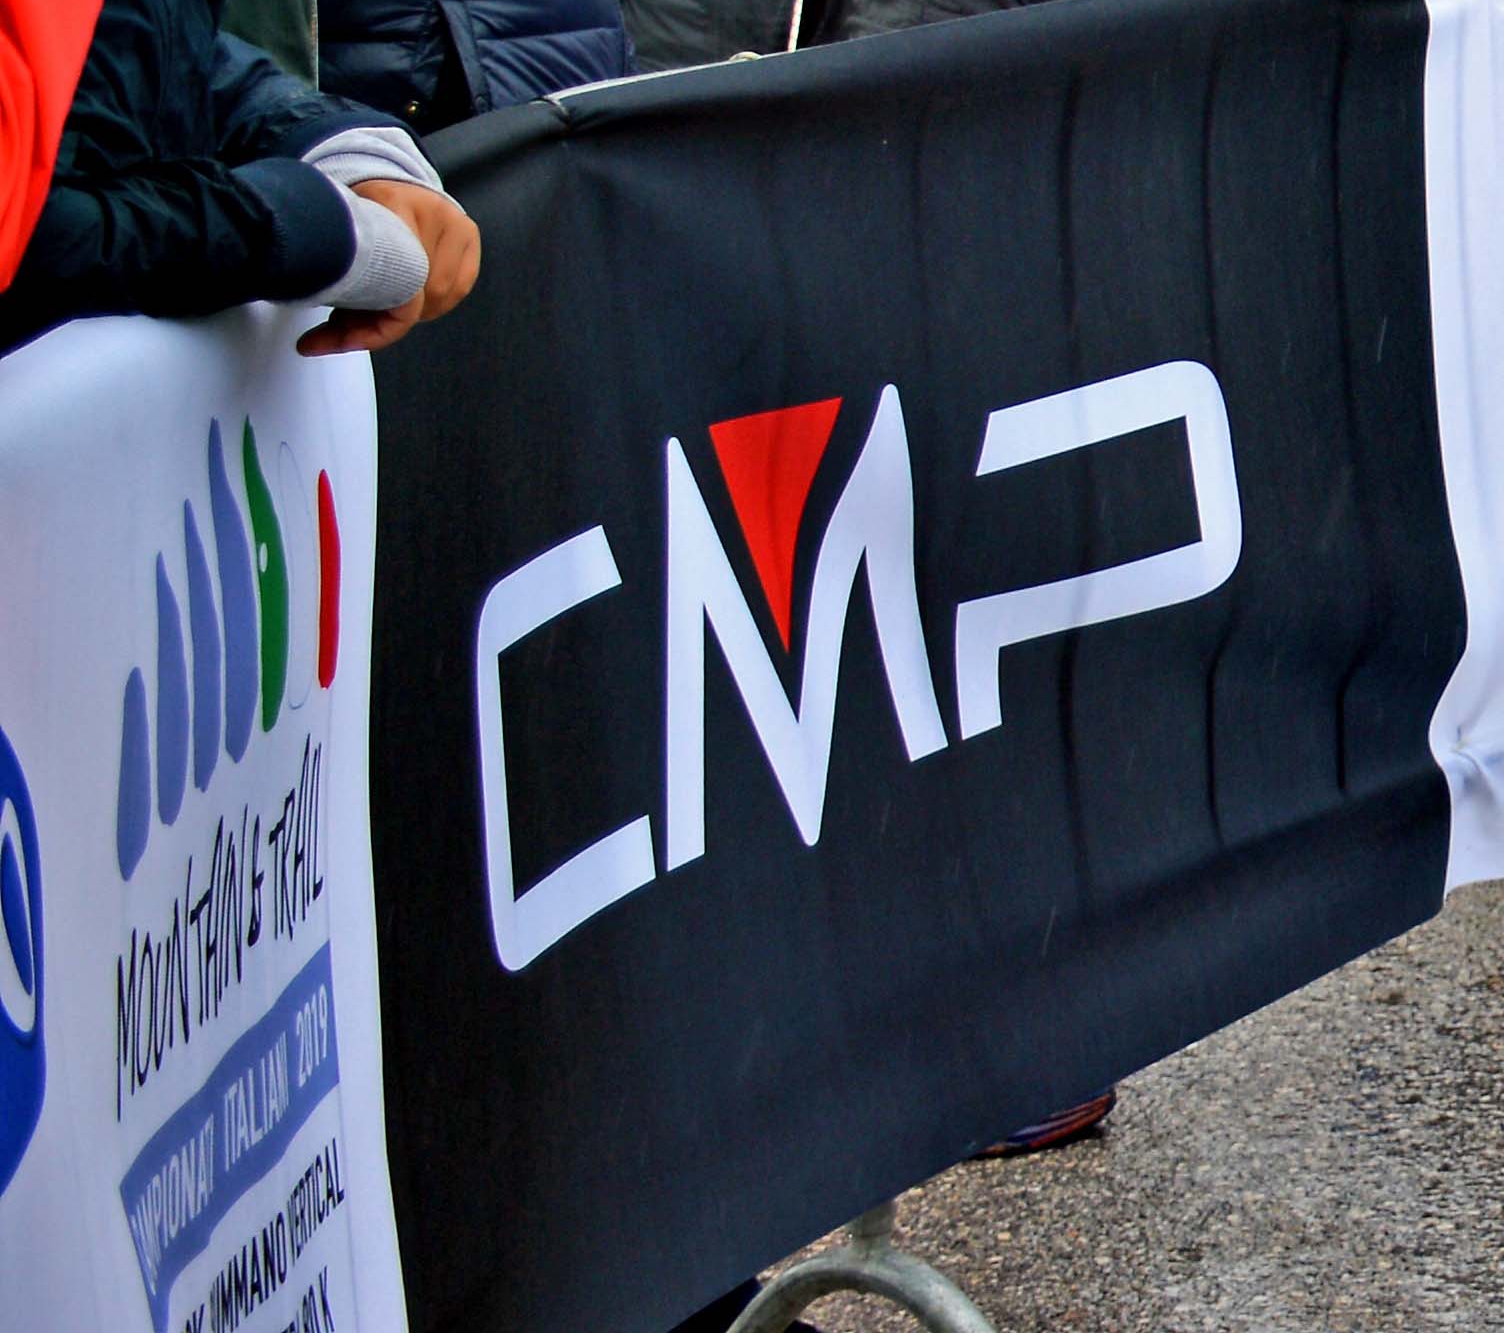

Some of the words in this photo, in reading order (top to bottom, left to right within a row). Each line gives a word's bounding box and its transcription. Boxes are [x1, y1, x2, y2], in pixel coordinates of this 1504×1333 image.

[476, 358, 1244, 973] CMP
[116, 802, 249, 1123] MOUNTAIN
[247, 813, 265, 948] &
[268, 732, 324, 942] TRAIL
[295, 984, 329, 1089] 2019
[287, 1137, 345, 1267] VERTICAL
